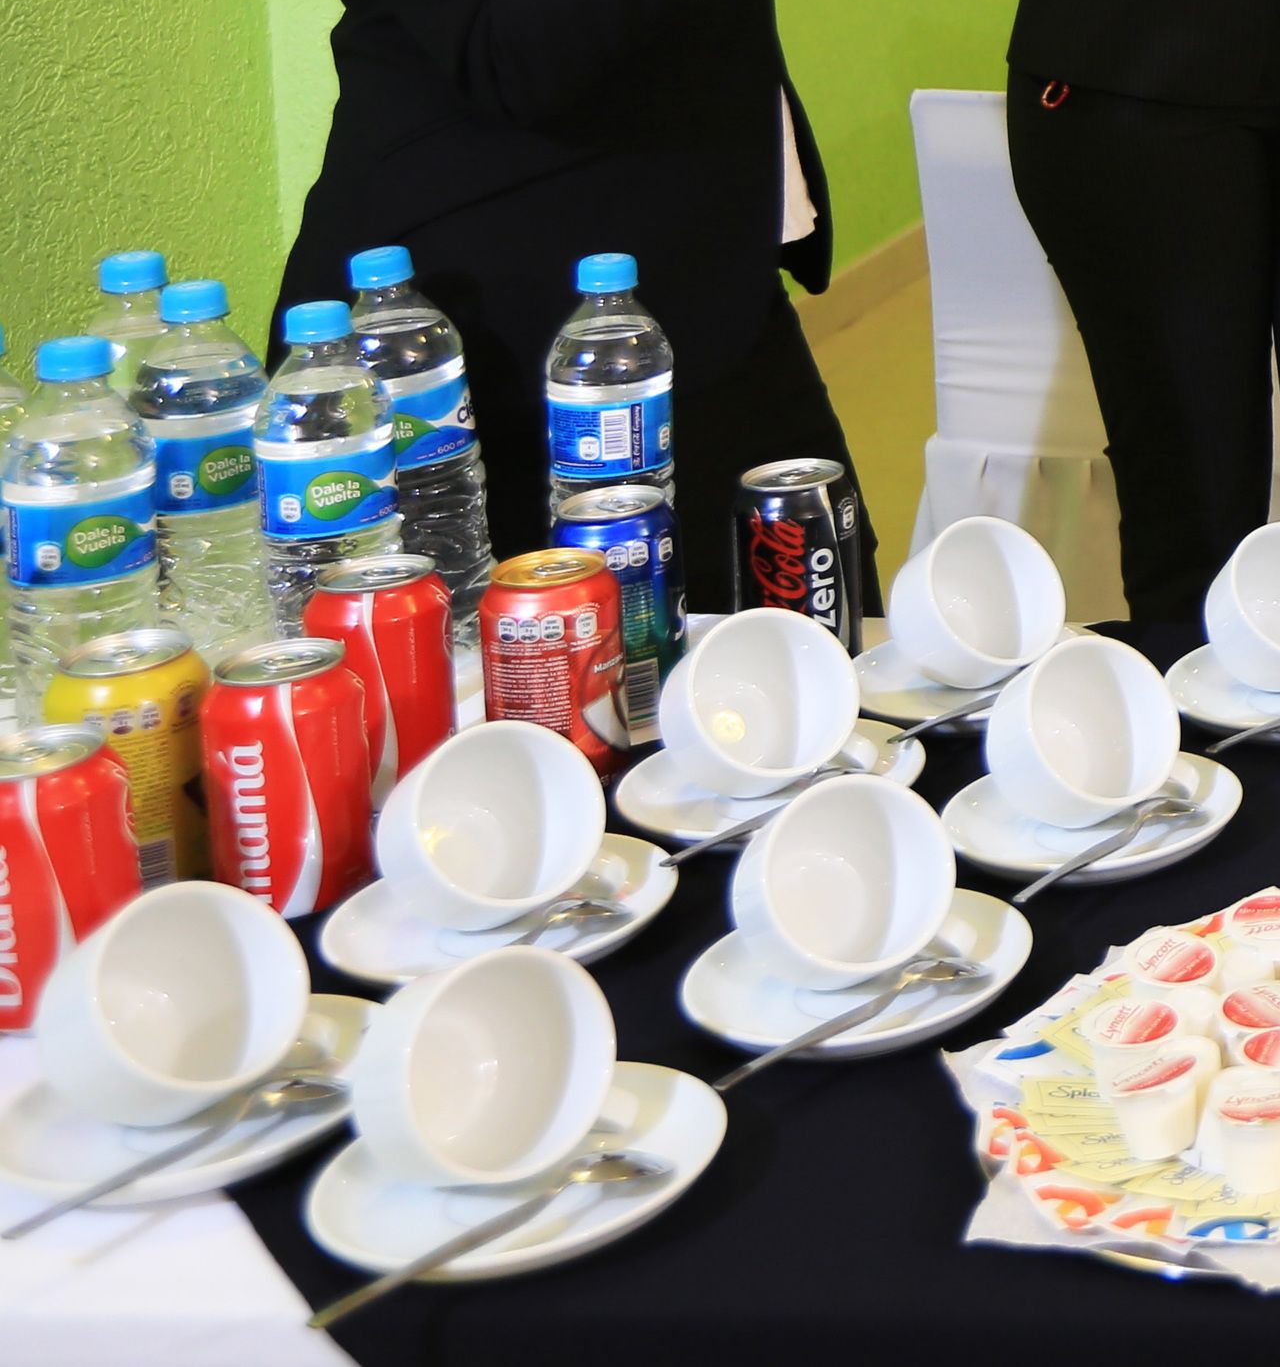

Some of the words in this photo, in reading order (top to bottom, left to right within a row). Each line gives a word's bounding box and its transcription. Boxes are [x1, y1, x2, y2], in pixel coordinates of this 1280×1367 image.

[437, 442, 455, 454] 600
[205, 457, 237, 474] Dale
[240, 454, 251, 464] la
[208, 463, 252, 483] vuelta
[311, 482, 345, 499] Dale
[348, 479, 360, 489] la
[314, 488, 361, 507] vuelta
[74, 526, 110, 545] Dale
[112, 524, 126, 535] la
[76, 534, 126, 555] vuelta
[811, 547, 837, 627] zero
[1140, 937, 1178, 972] Lyncott
[1100, 1004, 1134, 1040] Lyncott
